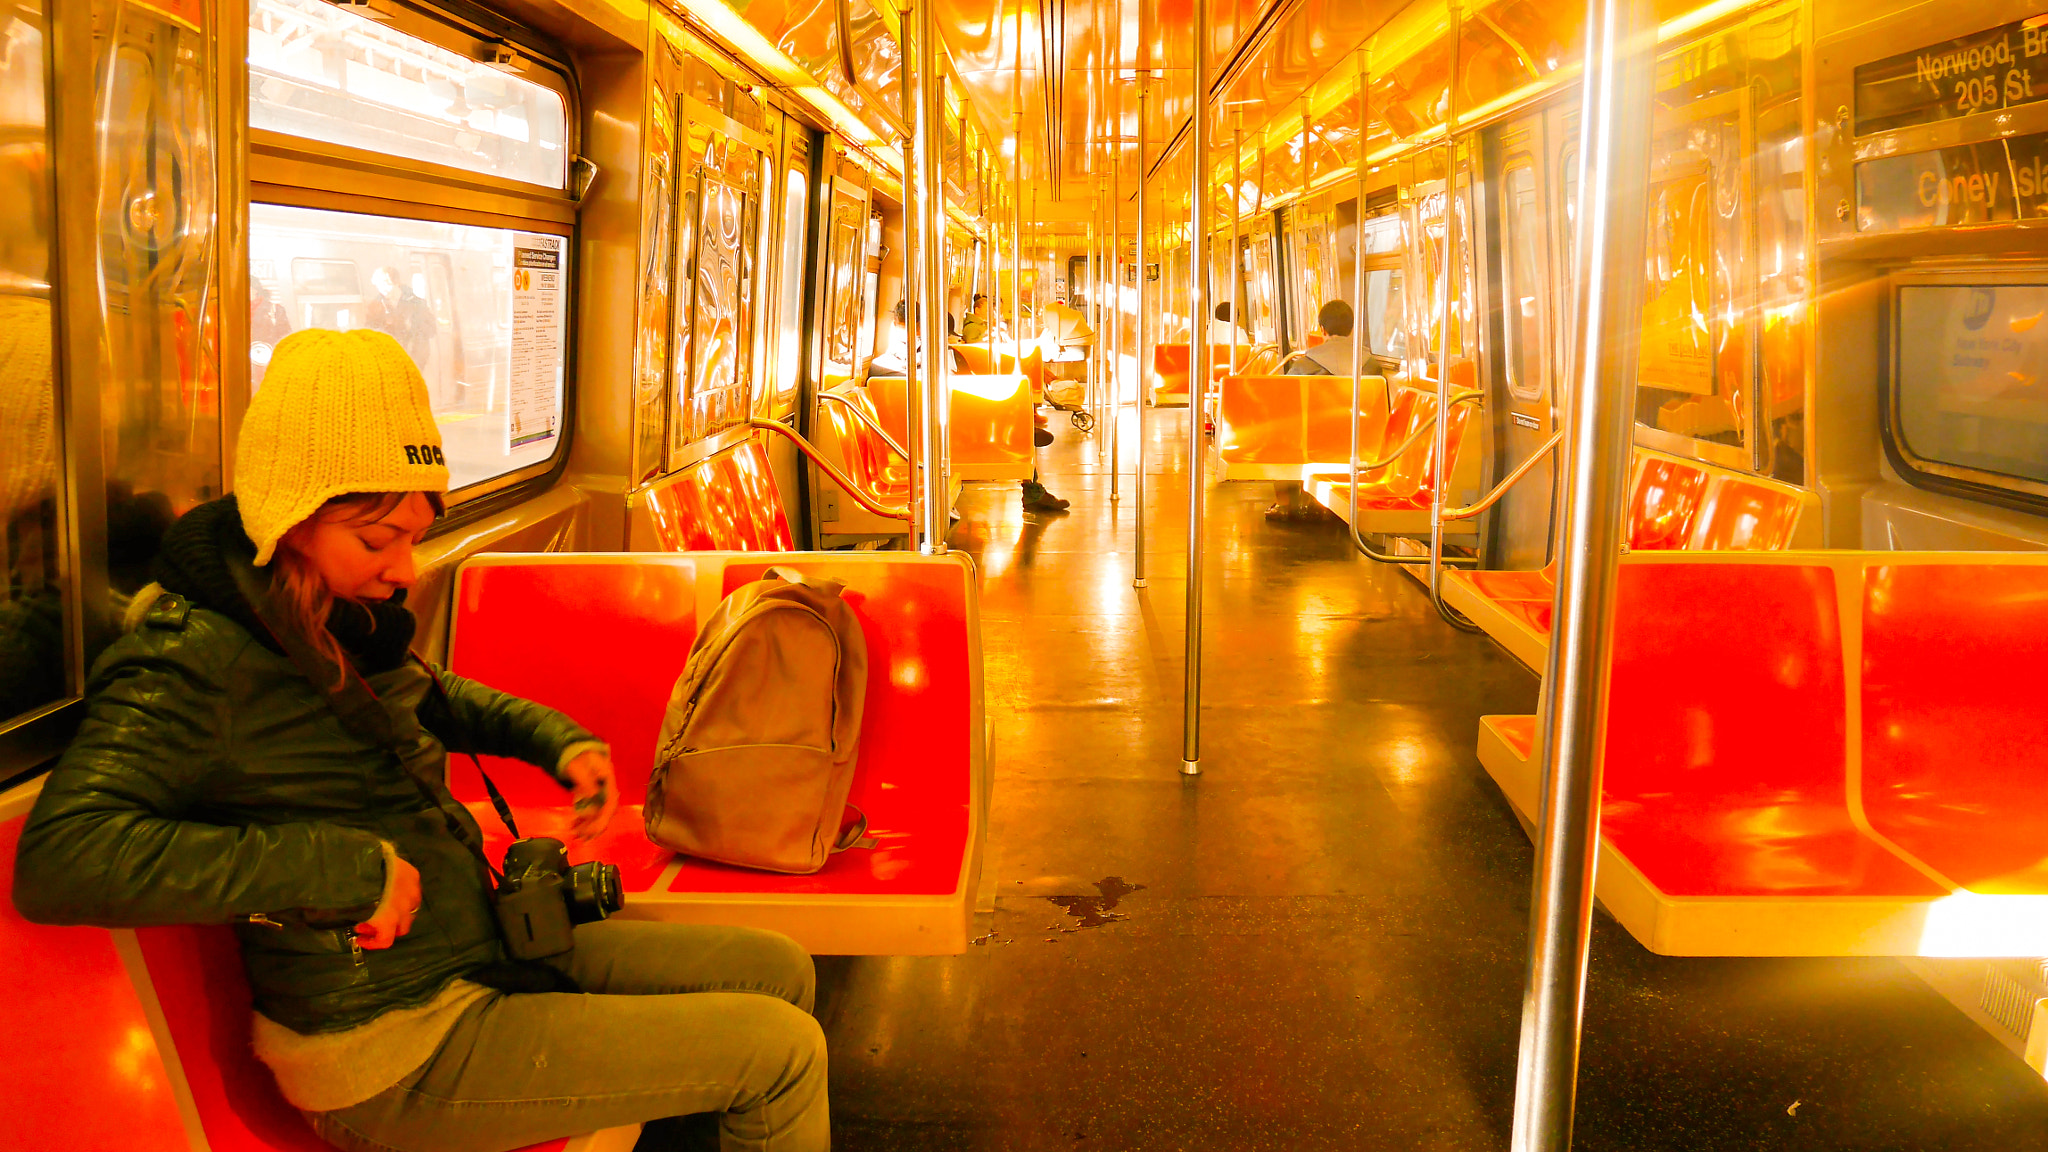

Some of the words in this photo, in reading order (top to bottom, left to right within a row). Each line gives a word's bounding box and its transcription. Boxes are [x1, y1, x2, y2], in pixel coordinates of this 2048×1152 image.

[1916, 33, 2016, 83] Norwood,
[1954, 75, 1998, 110] 205
[2006, 69, 2033, 101] St
[1918, 171, 1999, 208] Coney
